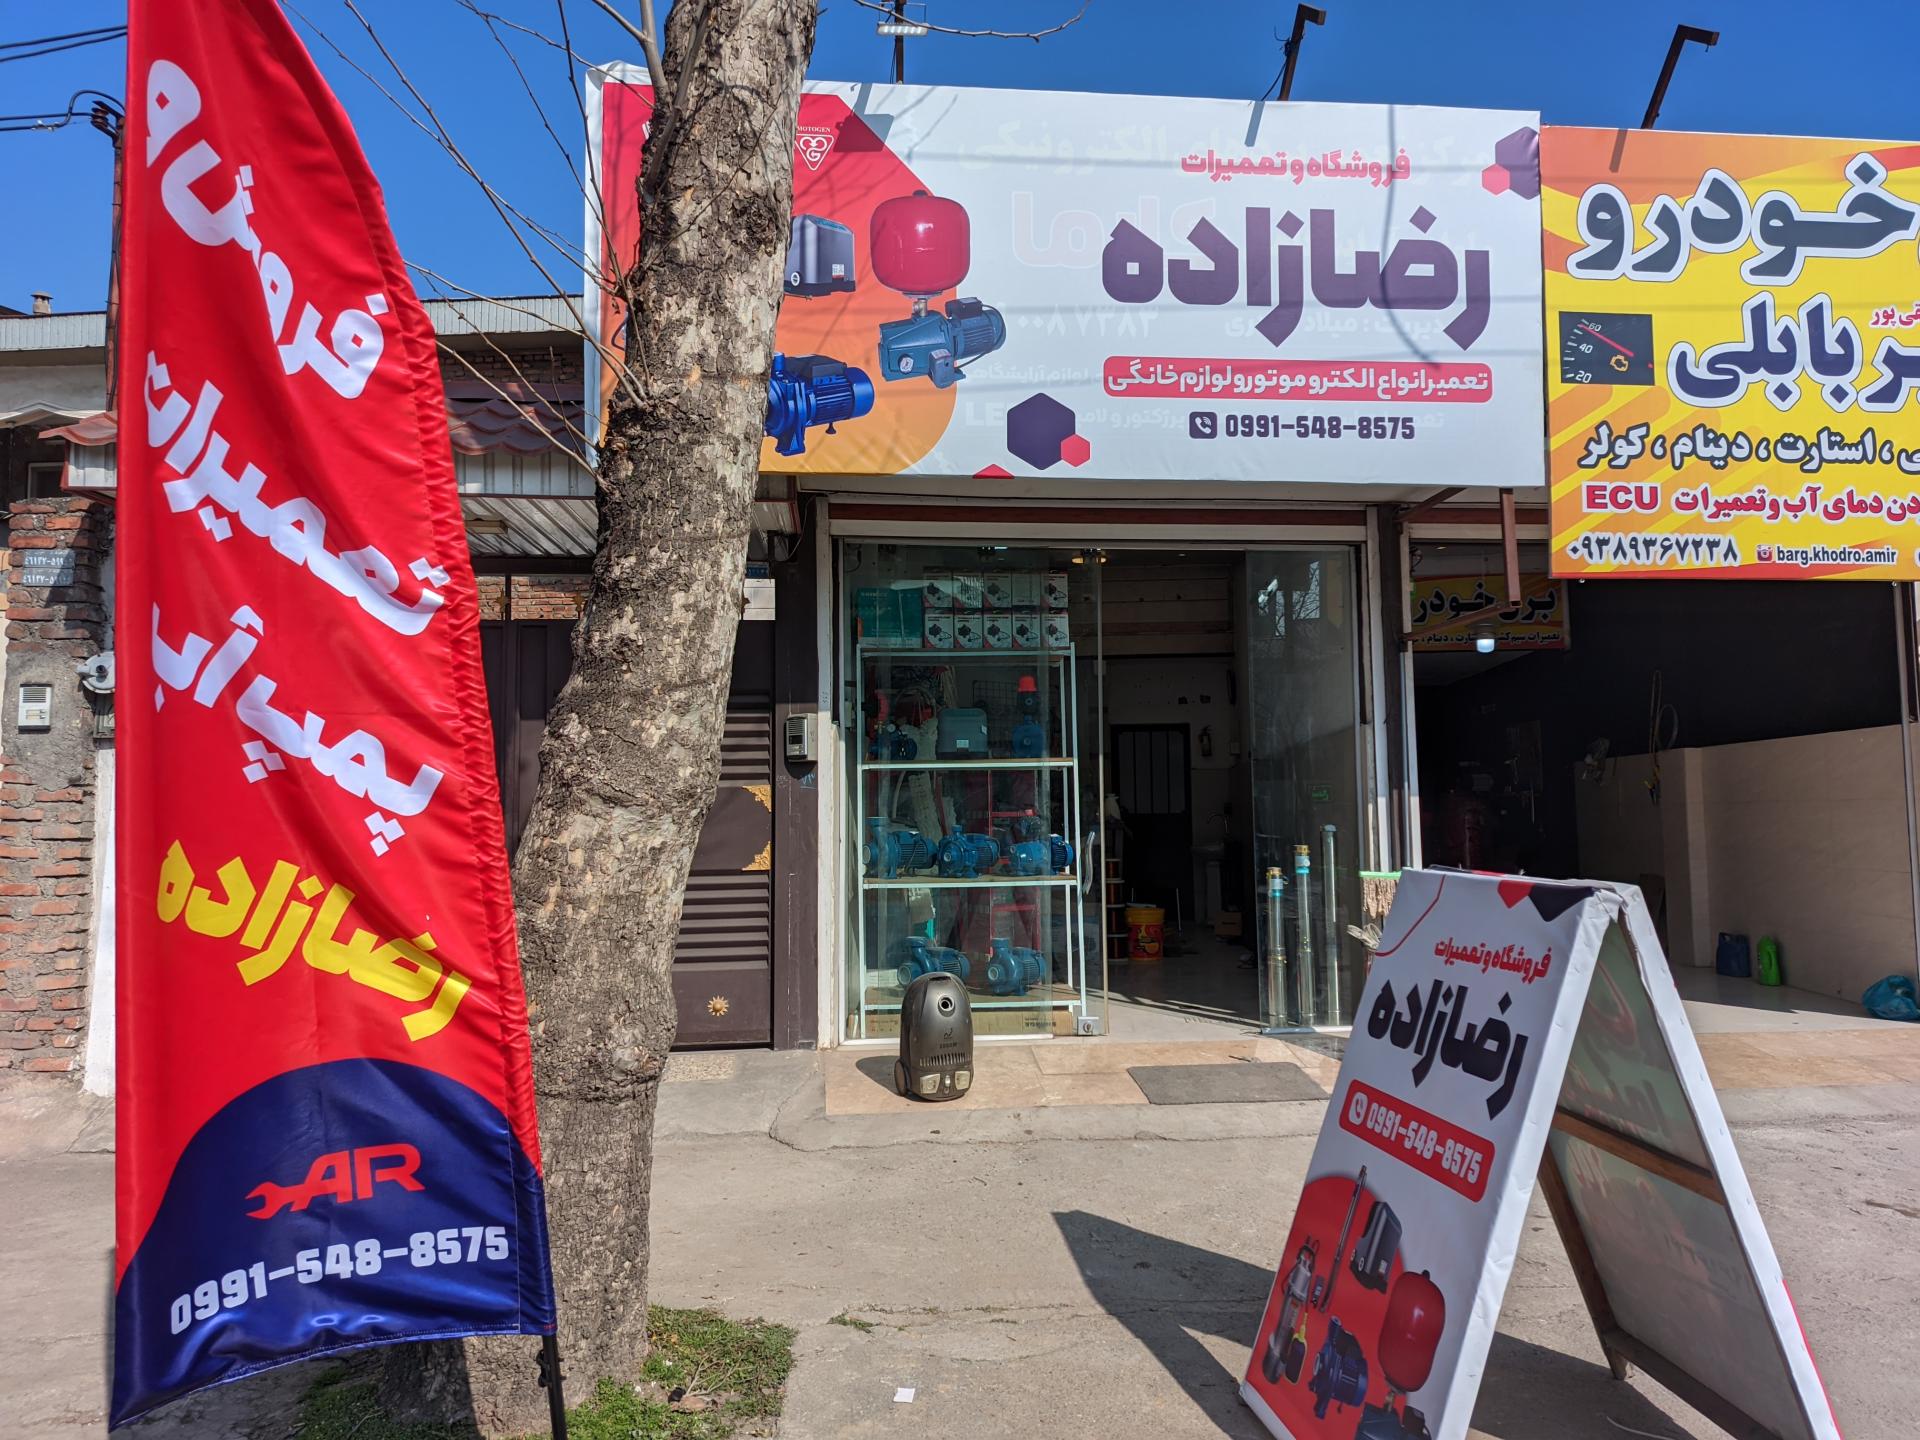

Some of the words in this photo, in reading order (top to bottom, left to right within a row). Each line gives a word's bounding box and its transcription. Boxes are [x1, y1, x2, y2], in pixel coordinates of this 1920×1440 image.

[1181, 149, 1288, 182] تعمیرات
[1291, 158, 1304, 185] و
[1306, 148, 1411, 188] فروشگاه
[1570, 155, 1918, 282] خودرو
[1102, 205, 1492, 351] رضازاده
[1578, 343, 1594, 354] 40
[1671, 296, 1859, 408] بابلی
[1575, 370, 1592, 384] 20
[1225, 414, 1416, 440] 0991-548-8575
[1577, 421, 1649, 468] کولر
[144, 350, 451, 636] تعمیرات
[1586, 484, 1660, 511] ECU
[1675, 486, 1767, 520] تعمیرات
[1783, 486, 1821, 520] آب
[1822, 489, 1884, 521] دمای
[1776, 546, 1897, 565] barg.khodro.amir
[157, 840, 472, 1042] رضازاده
[1435, 936, 1487, 966] تعمیرات
[1492, 944, 1552, 984] فروشگاه
[1367, 979, 1529, 1121] رضازاده
[1366, 1102, 1483, 1184] 0991-548-8575
[170, 1226, 510, 1335] 0991-548-8575
